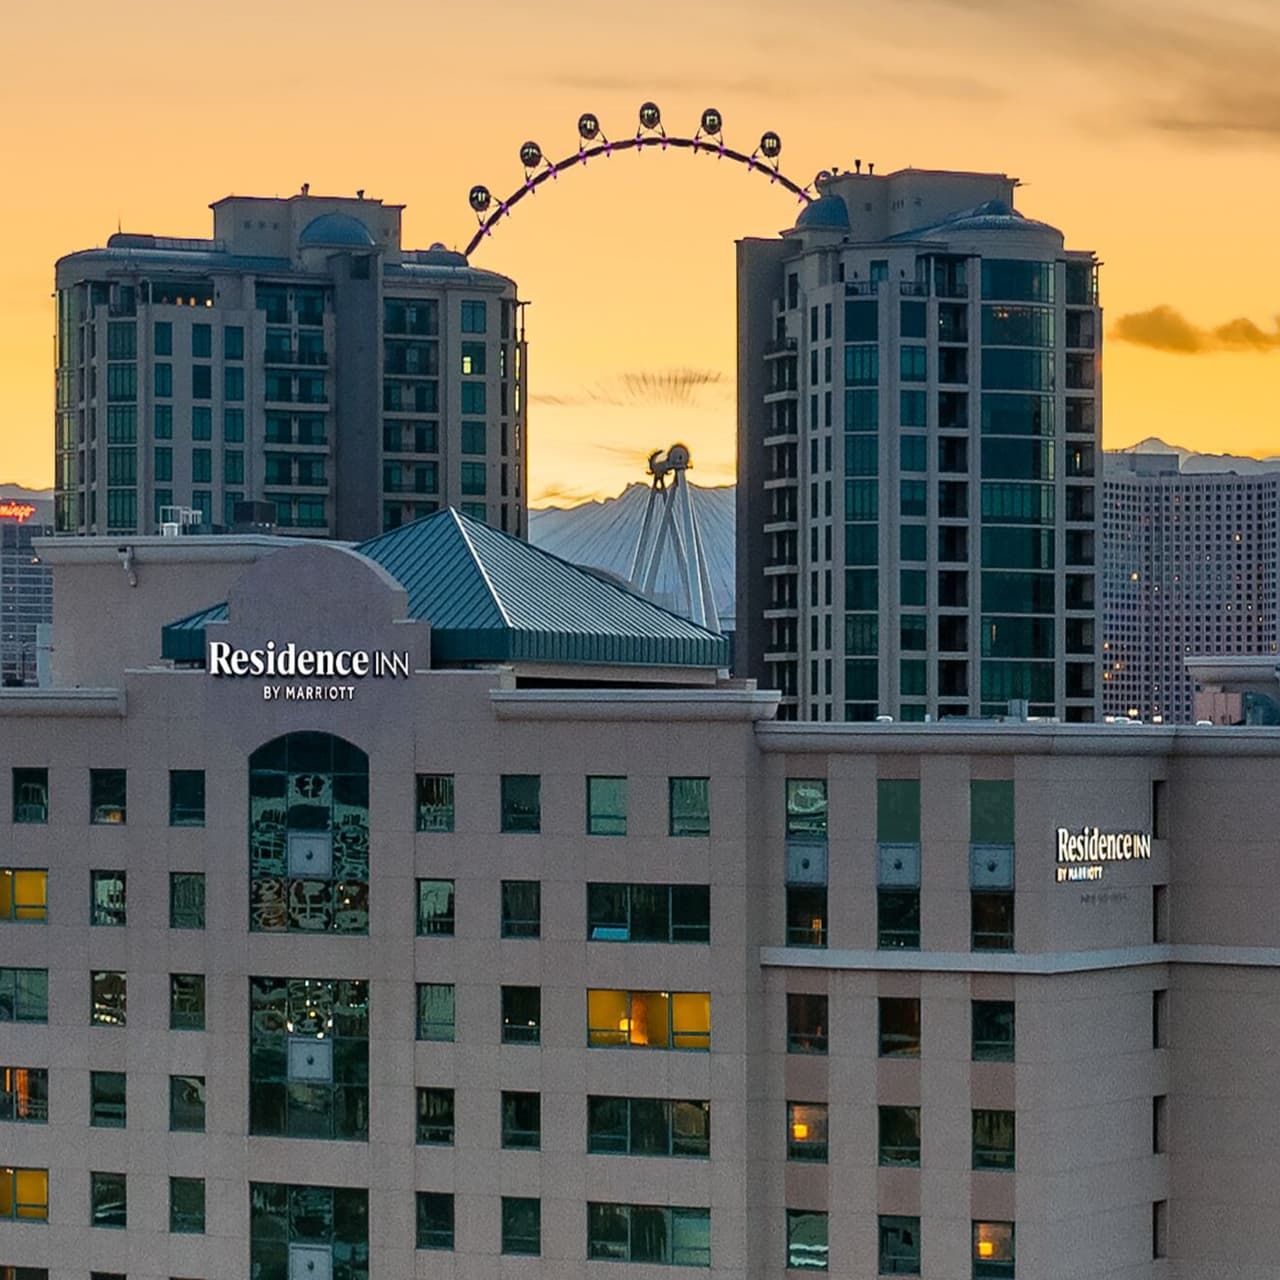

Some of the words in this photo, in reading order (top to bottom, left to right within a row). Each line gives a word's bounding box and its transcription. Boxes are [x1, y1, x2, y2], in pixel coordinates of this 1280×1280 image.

[210, 641, 368, 676] Residence
[375, 651, 409, 676] INN
[263, 686, 281, 699] BY
[286, 686, 355, 700] MARRIOTT
[1058, 826, 1132, 862] Residence
[1133, 834, 1151, 858] INN
